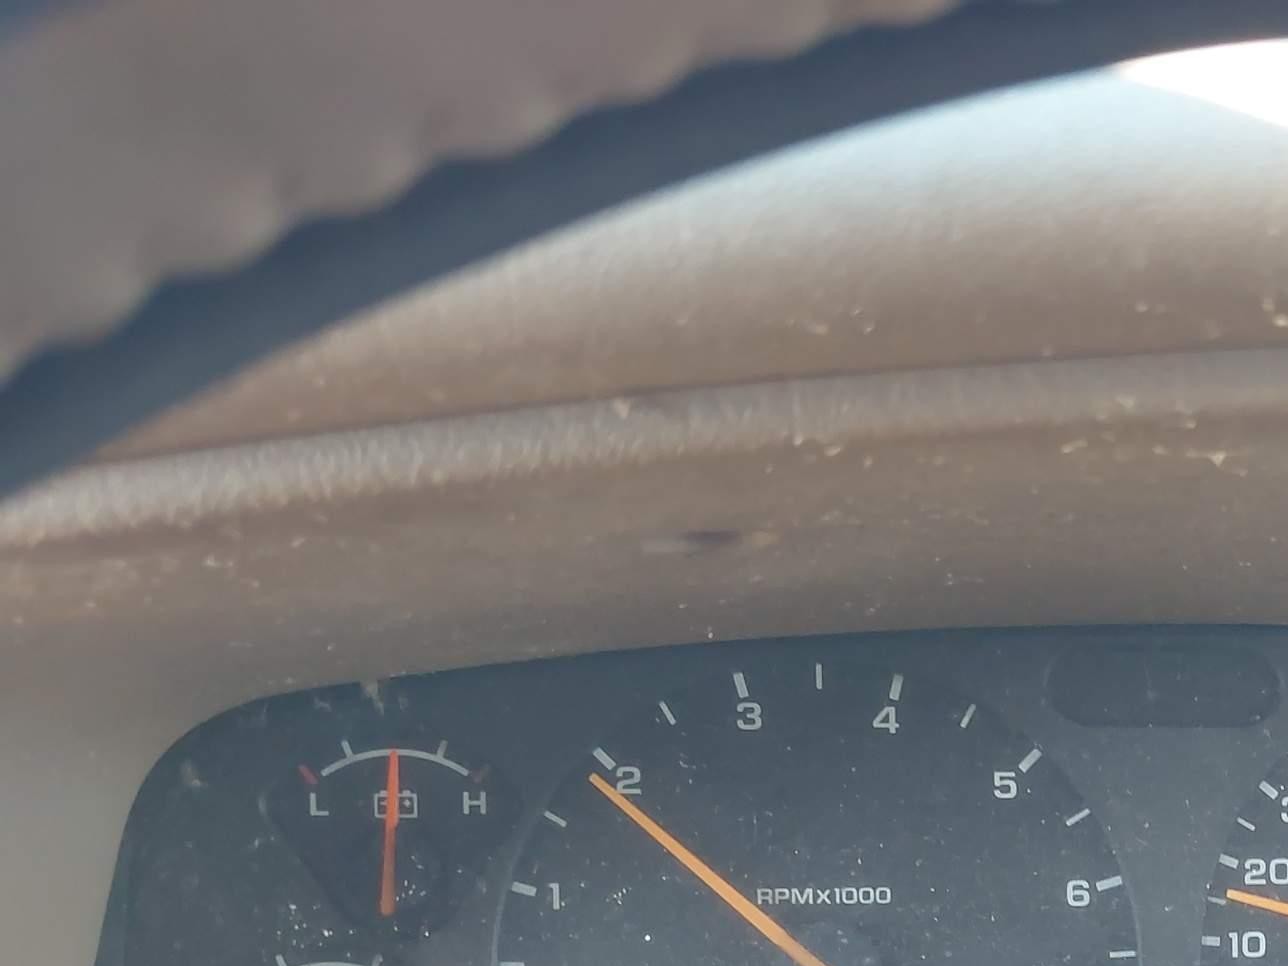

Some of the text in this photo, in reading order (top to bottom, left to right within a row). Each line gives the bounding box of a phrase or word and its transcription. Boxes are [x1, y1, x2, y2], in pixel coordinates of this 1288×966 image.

[736, 700, 763, 732] 3
[871, 703, 901, 735] 4
[614, 764, 643, 797] 2
[993, 769, 1018, 801] 5
[309, 793, 328, 817] L
[462, 792, 487, 815] H
[549, 884, 561, 910] 1
[1064, 880, 1091, 908] 6
[1229, 931, 1266, 959] 10
